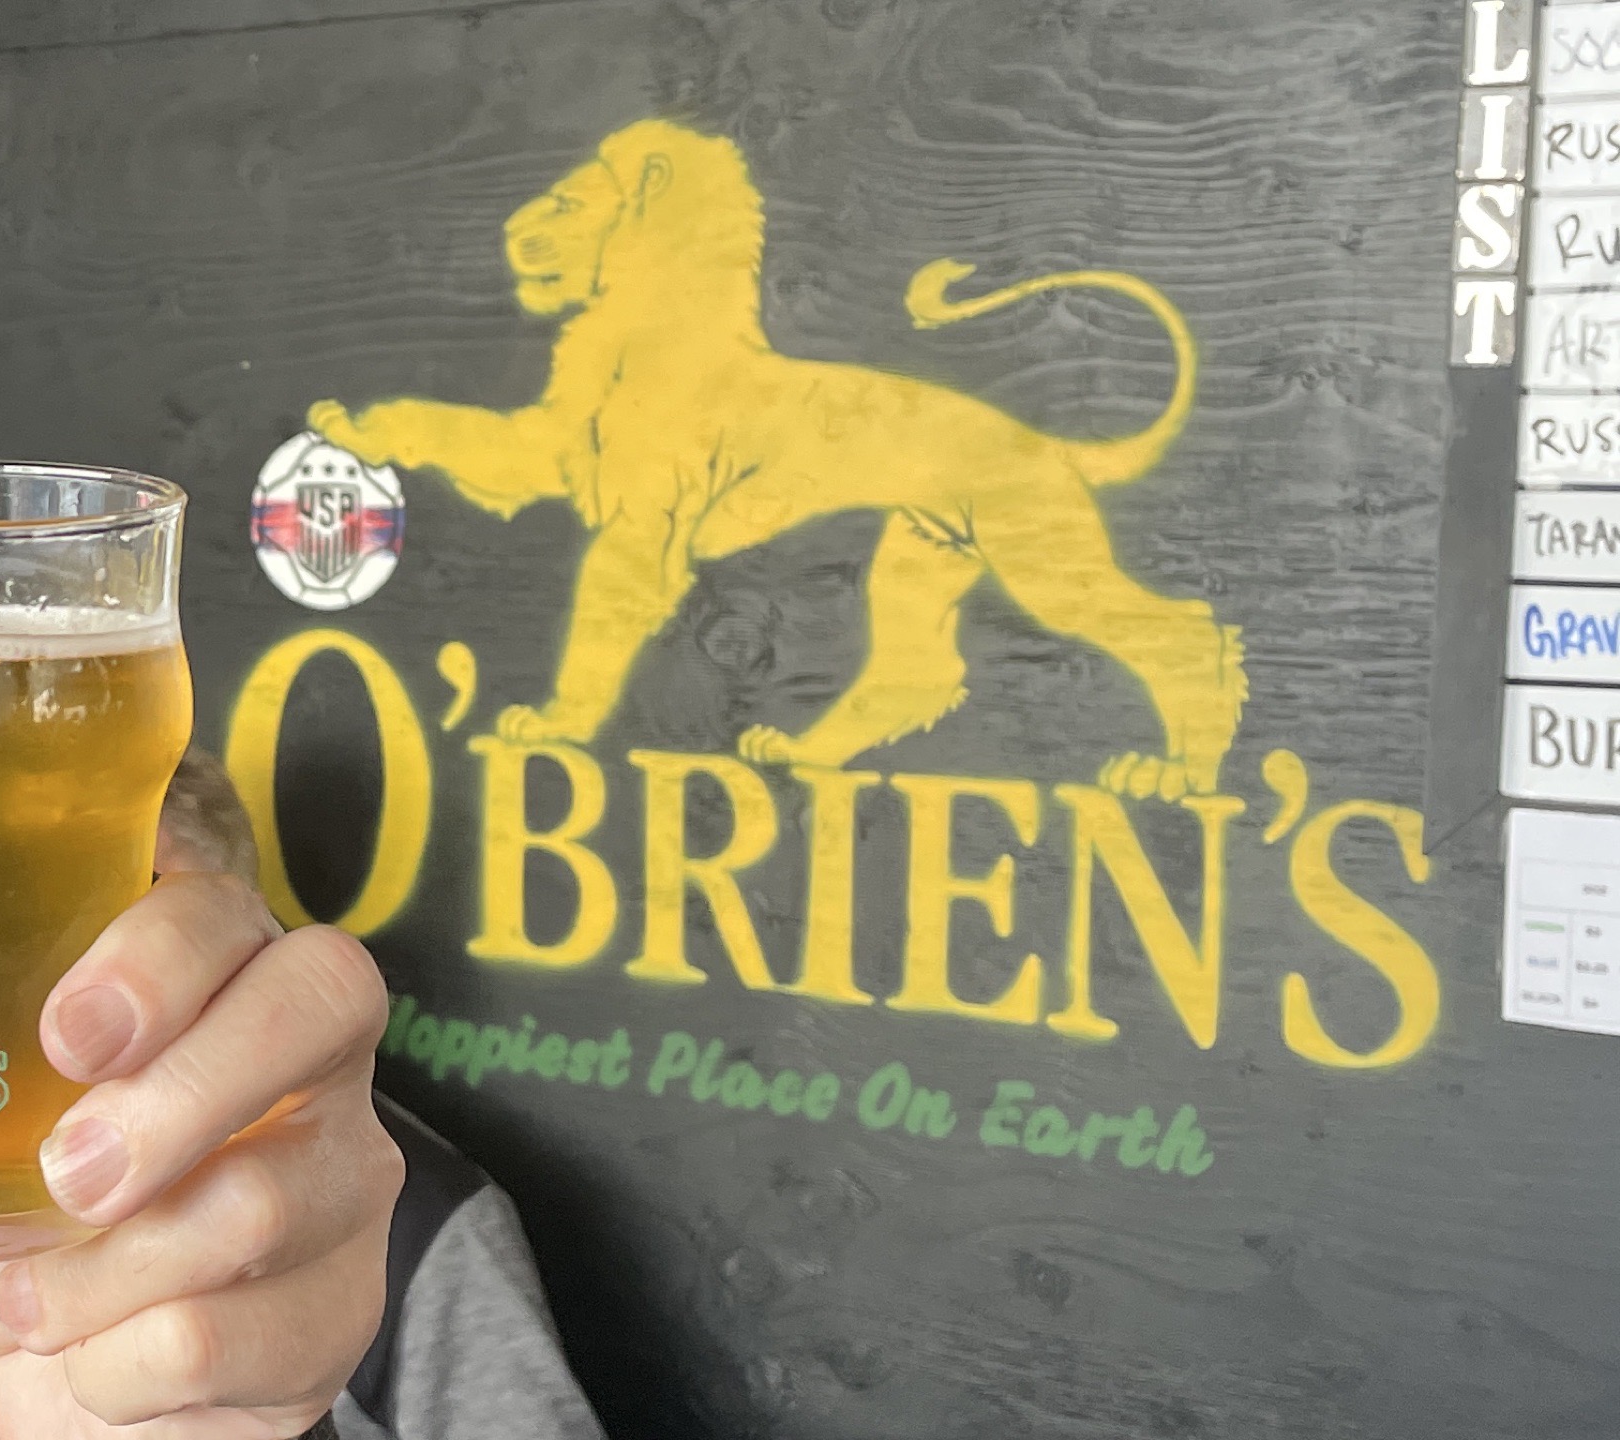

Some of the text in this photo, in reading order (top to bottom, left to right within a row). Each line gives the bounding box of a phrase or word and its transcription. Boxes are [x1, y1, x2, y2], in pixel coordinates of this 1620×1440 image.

[1454, 0, 1531, 365] LIST
[228, 628, 1440, 1069] O'BRIEN'S
[648, 1031, 841, 1121] Place
[856, 1061, 957, 1139] On
[980, 1079, 1215, 1176] Earth
